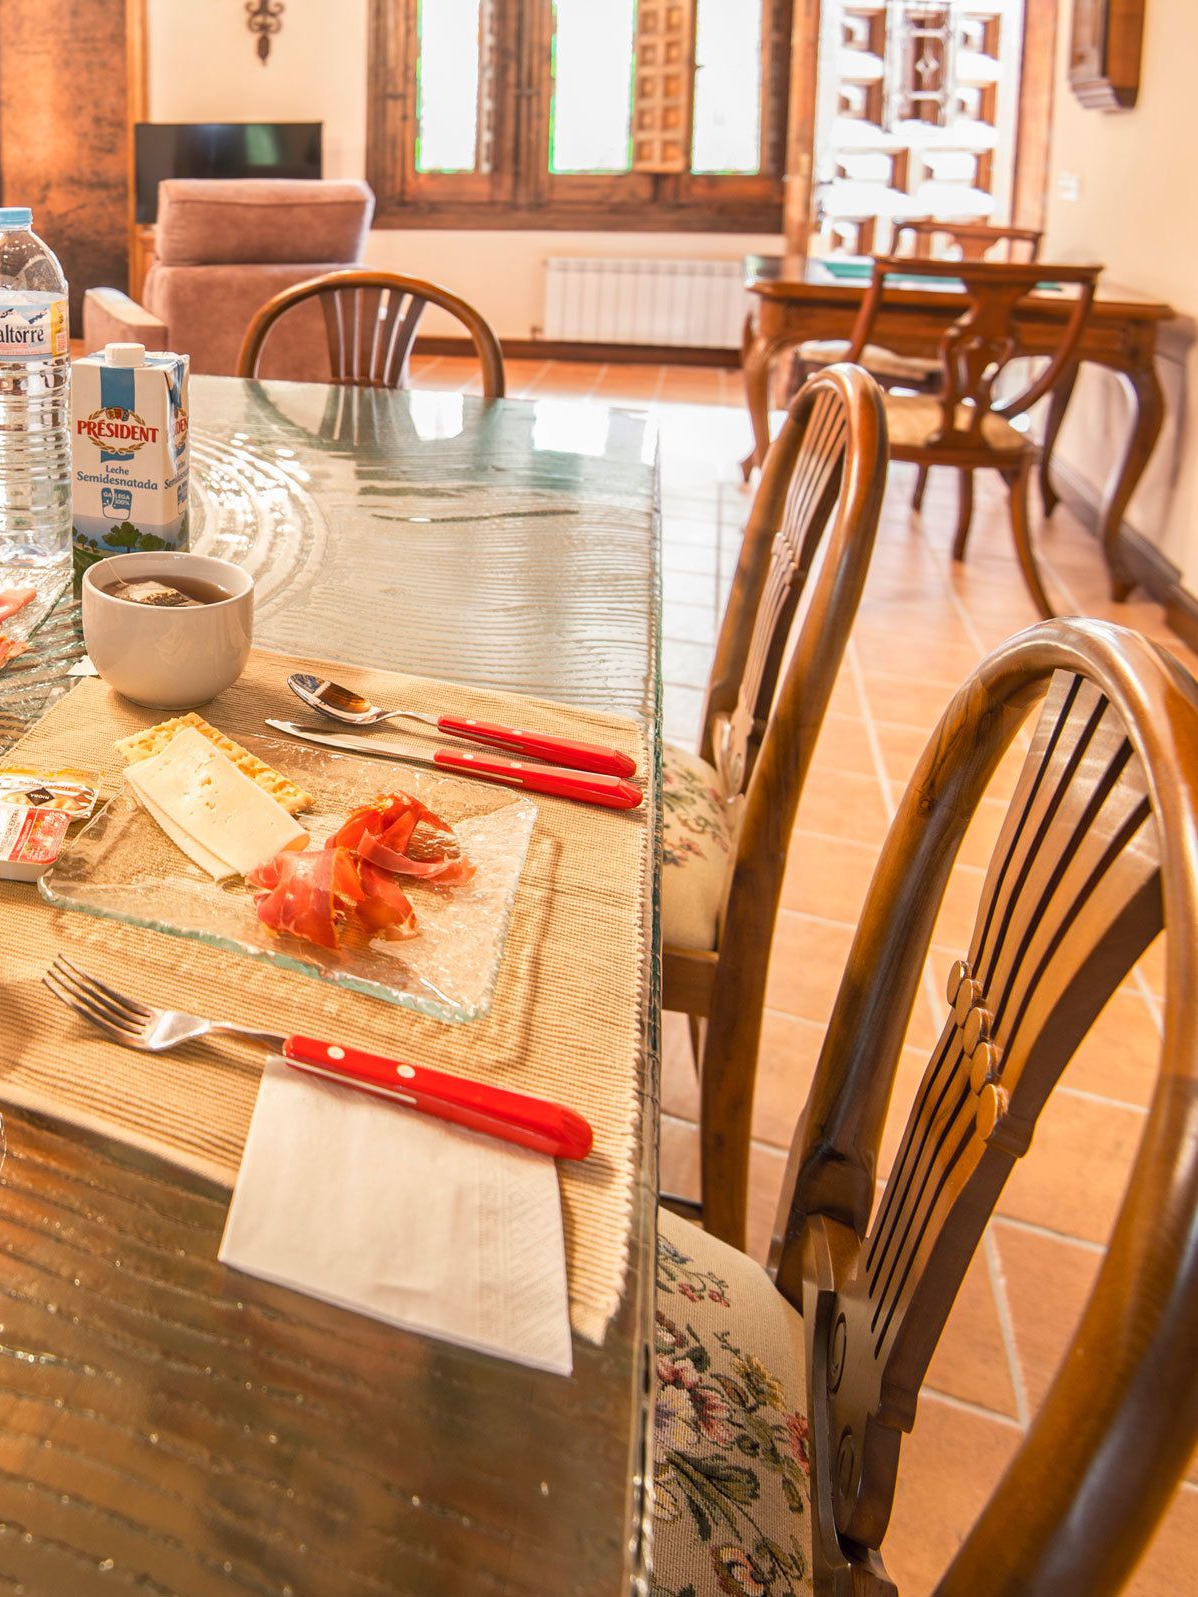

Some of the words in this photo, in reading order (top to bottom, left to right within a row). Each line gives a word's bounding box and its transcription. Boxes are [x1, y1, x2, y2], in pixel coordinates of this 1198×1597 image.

[77, 419, 159, 443] PRÉSIDENT
[105, 464, 129, 475] Leche
[76, 470, 158, 490] Semidesnatada
